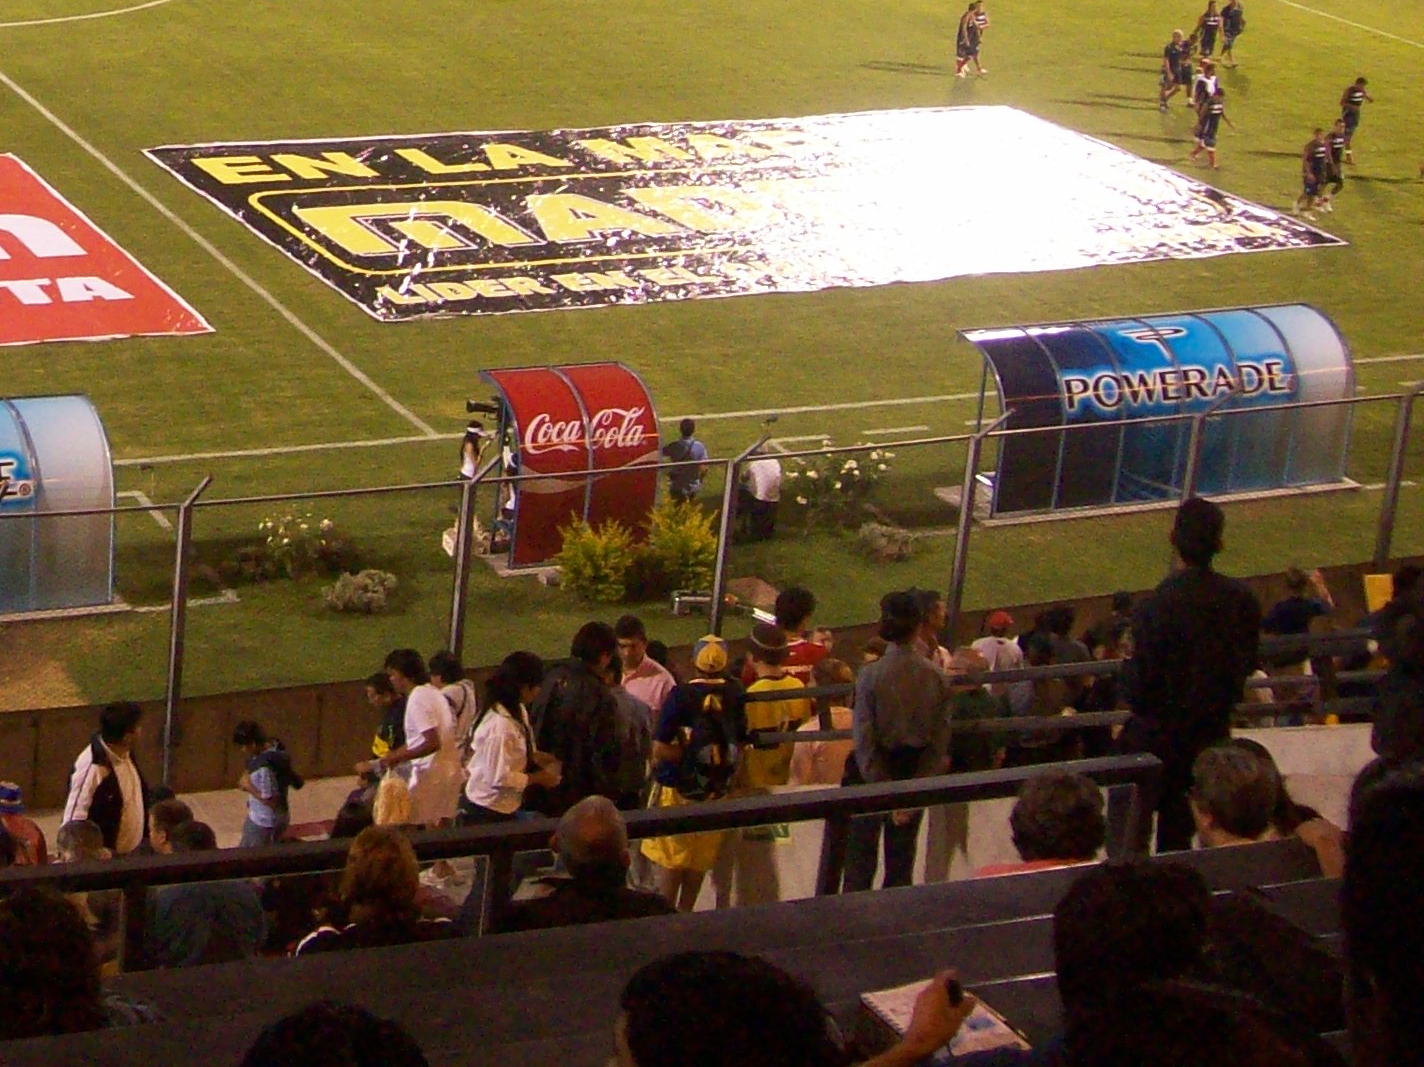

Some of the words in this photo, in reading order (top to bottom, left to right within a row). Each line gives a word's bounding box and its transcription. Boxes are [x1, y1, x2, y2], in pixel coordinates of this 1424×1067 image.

[191, 152, 378, 185] EN
[396, 143, 574, 176] LA
[382, 275, 554, 306] LIDER
[1063, 360, 1286, 411] POWERADE
